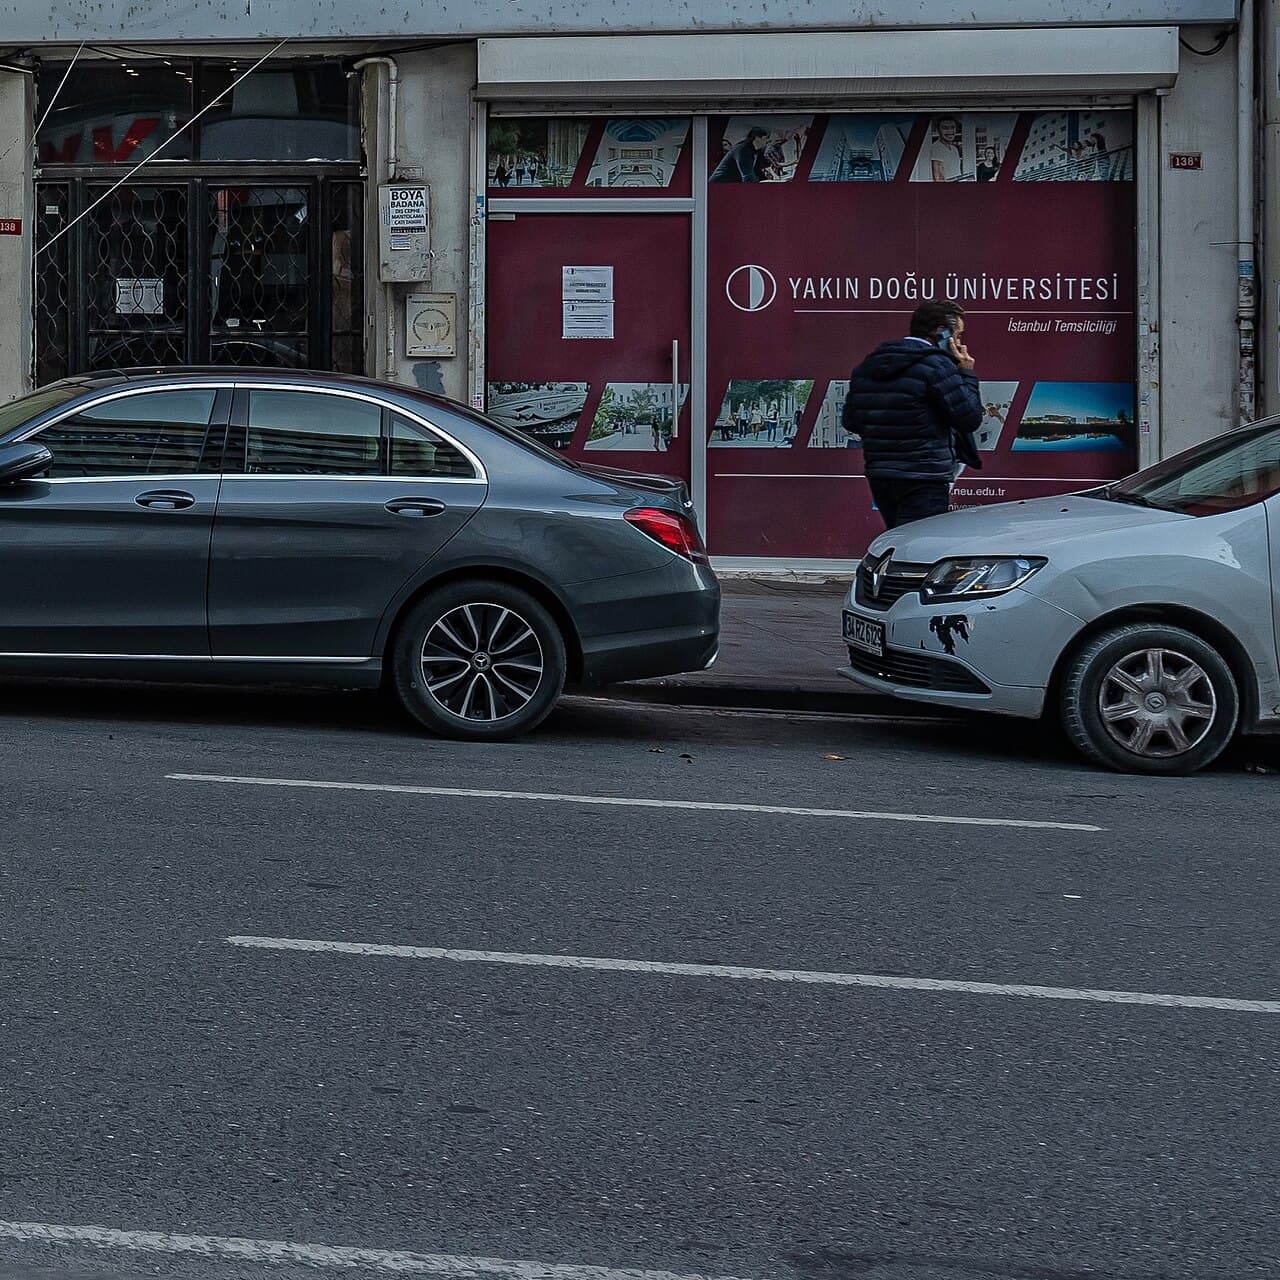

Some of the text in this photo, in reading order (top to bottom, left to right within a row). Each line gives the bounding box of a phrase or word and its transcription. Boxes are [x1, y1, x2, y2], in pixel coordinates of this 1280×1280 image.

[391, 191, 424, 201] BOYA
[390, 200, 425, 209] BADANA
[0, 222, 16, 232] 138
[789, 272, 1119, 301] YAKIN DOĞU ÜNİVERSİTESİ
[1007, 317, 1117, 335] İstanbul Temsilciliği
